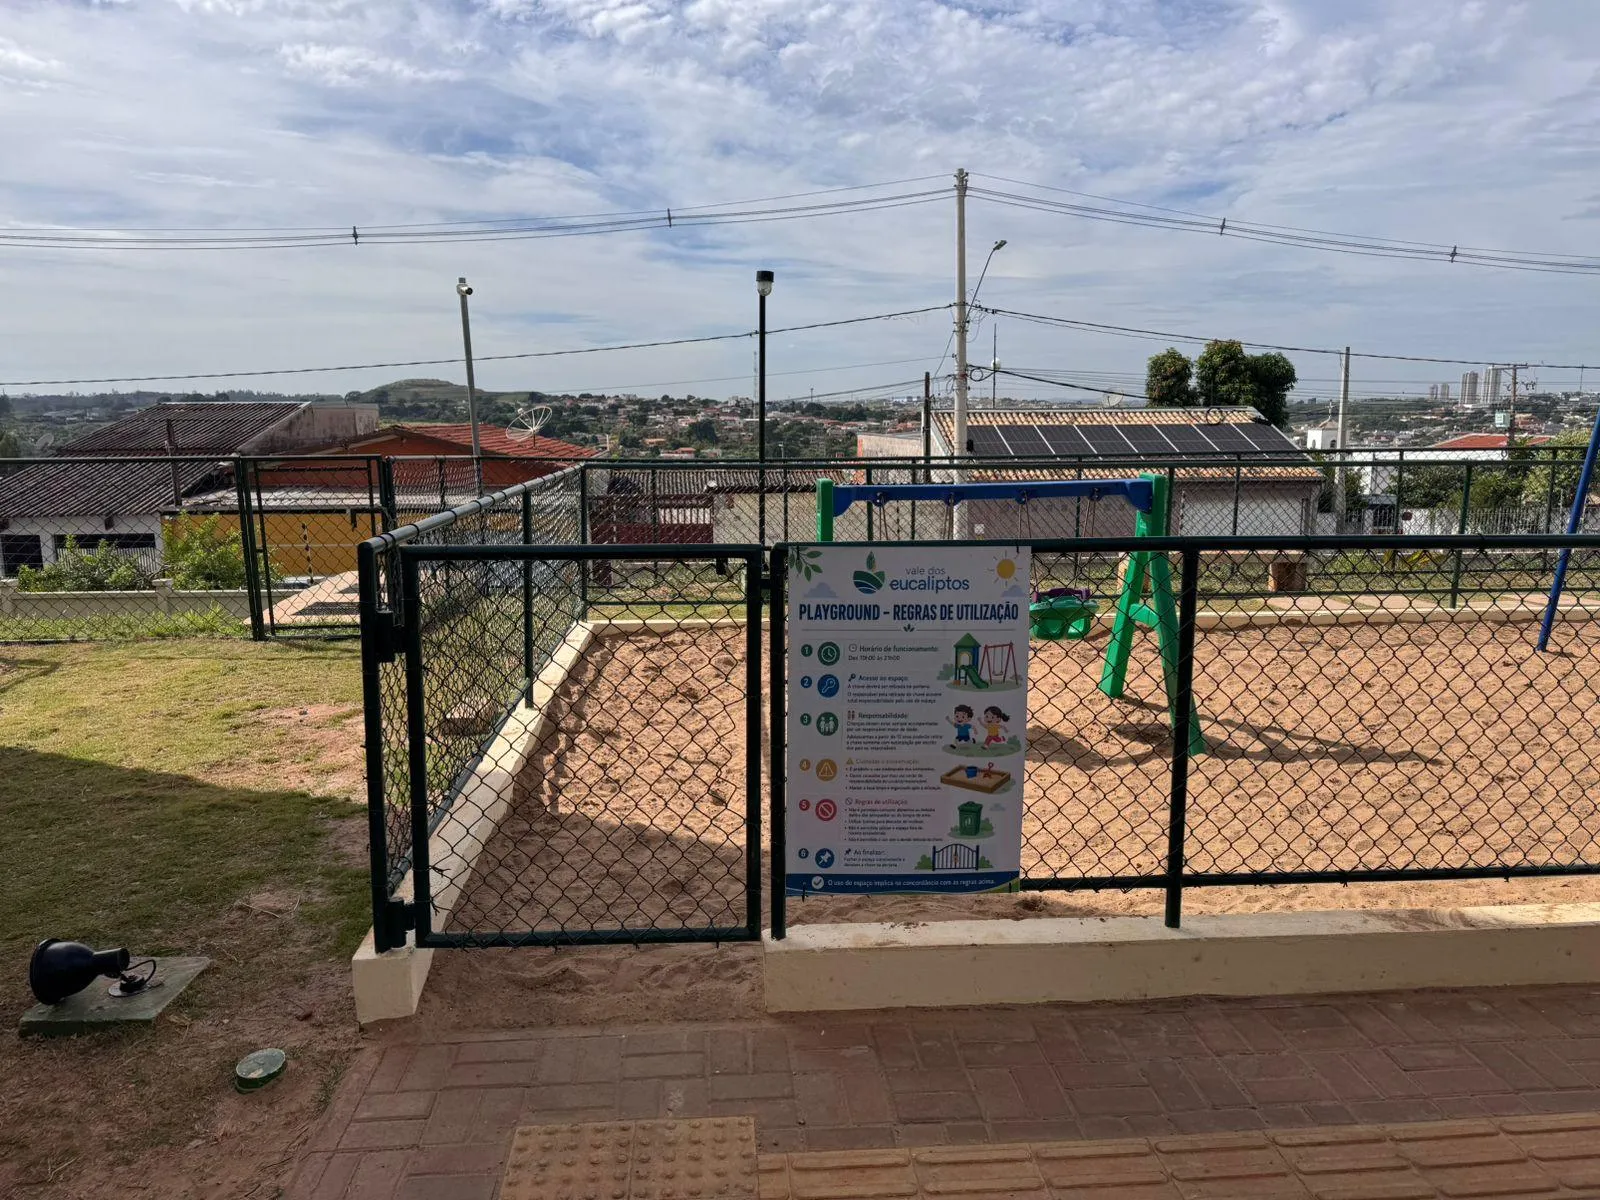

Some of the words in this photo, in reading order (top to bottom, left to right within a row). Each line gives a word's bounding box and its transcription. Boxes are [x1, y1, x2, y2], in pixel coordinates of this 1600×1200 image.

[905, 566, 926, 576] vale
[927, 566, 946, 576] dos
[889, 575, 970, 594] eucaliptos
[799, 603, 880, 621] PLAYGROUND
[893, 603, 937, 621] REGRAS
[940, 603, 955, 621] DE
[957, 601, 1019, 623] UTILIZAÇÃO
[859, 644, 882, 652] Horário
[884, 644, 891, 652] de
[853, 879, 872, 888] espaço
[874, 879, 894, 887] implica
[903, 878, 938, 886] concordância
[960, 879, 977, 887] regras
